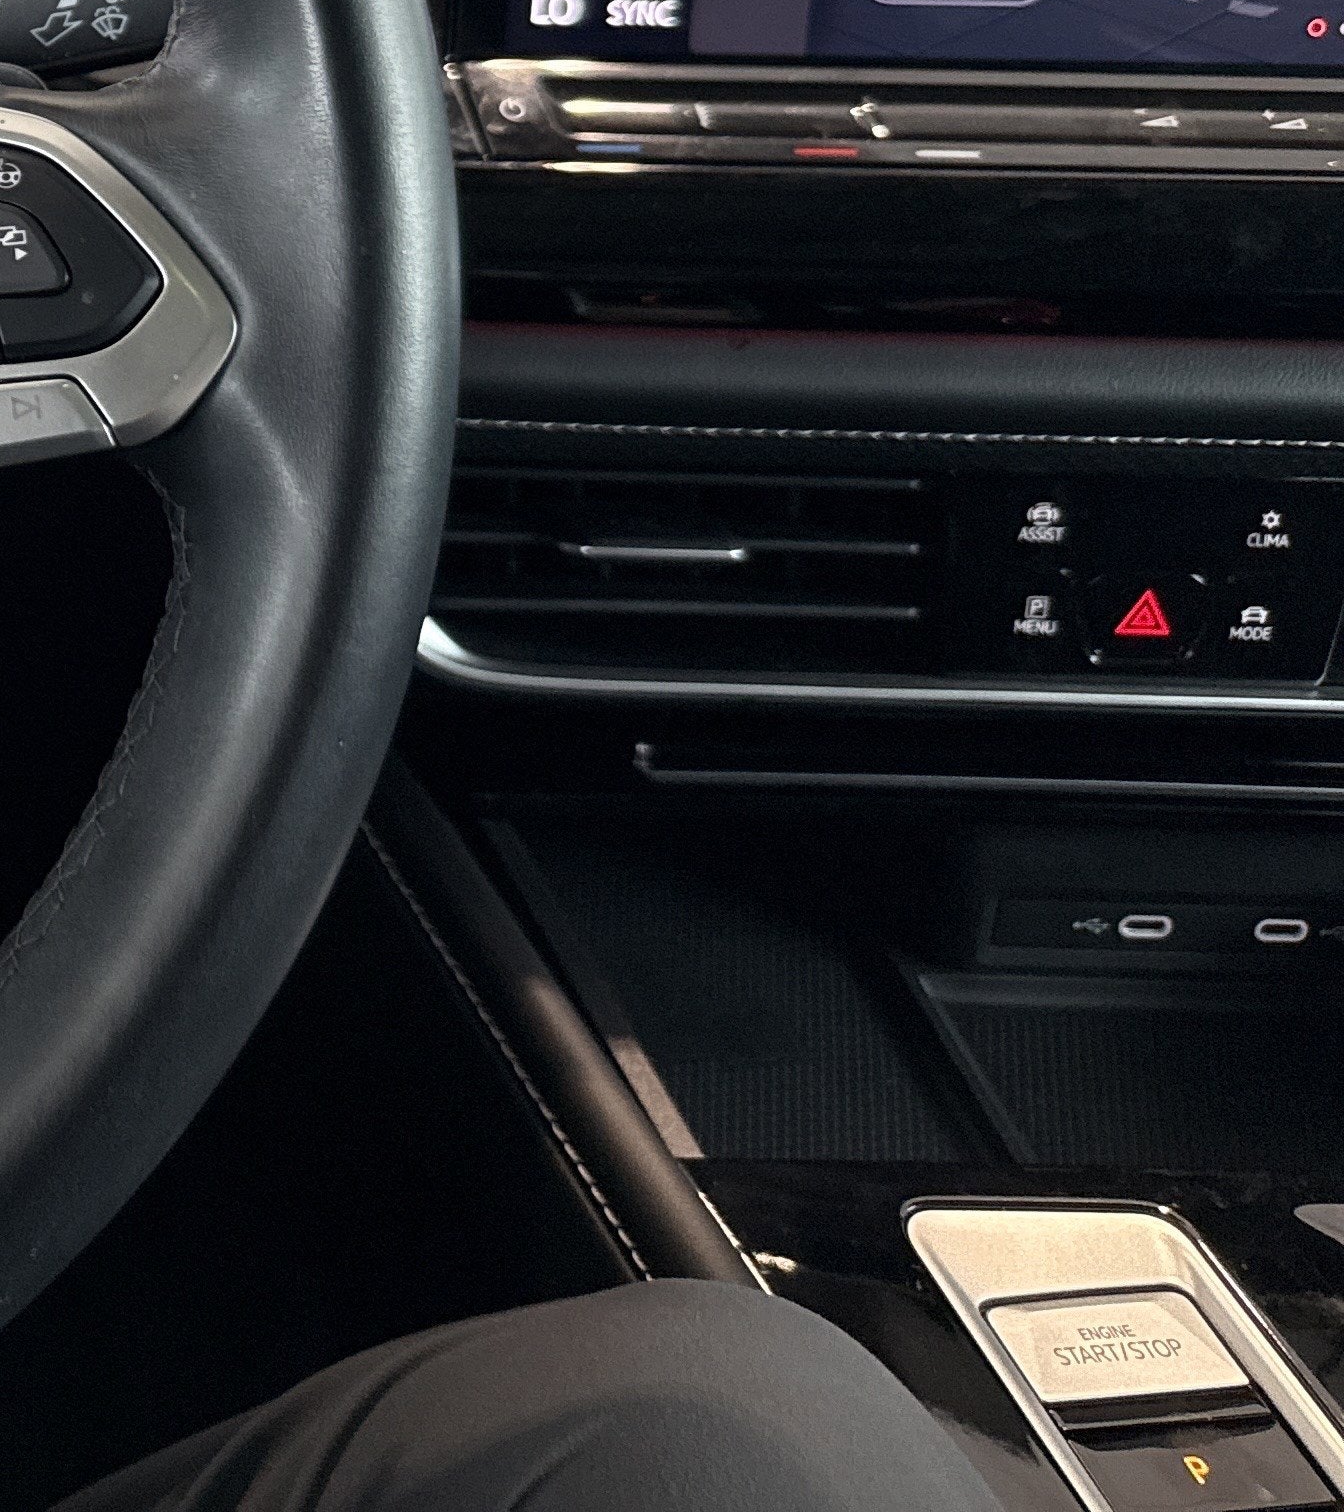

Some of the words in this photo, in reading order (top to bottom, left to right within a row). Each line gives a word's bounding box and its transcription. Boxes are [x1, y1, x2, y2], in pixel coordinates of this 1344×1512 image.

[1017, 526, 1066, 542] ASSIST
[1245, 532, 1291, 549] CLIMA
[1012, 619, 1060, 636] MENU
[1228, 625, 1275, 642] MODE
[1077, 1324, 1136, 1341] ENGINE
[1053, 1337, 1182, 1366] START/STOP
